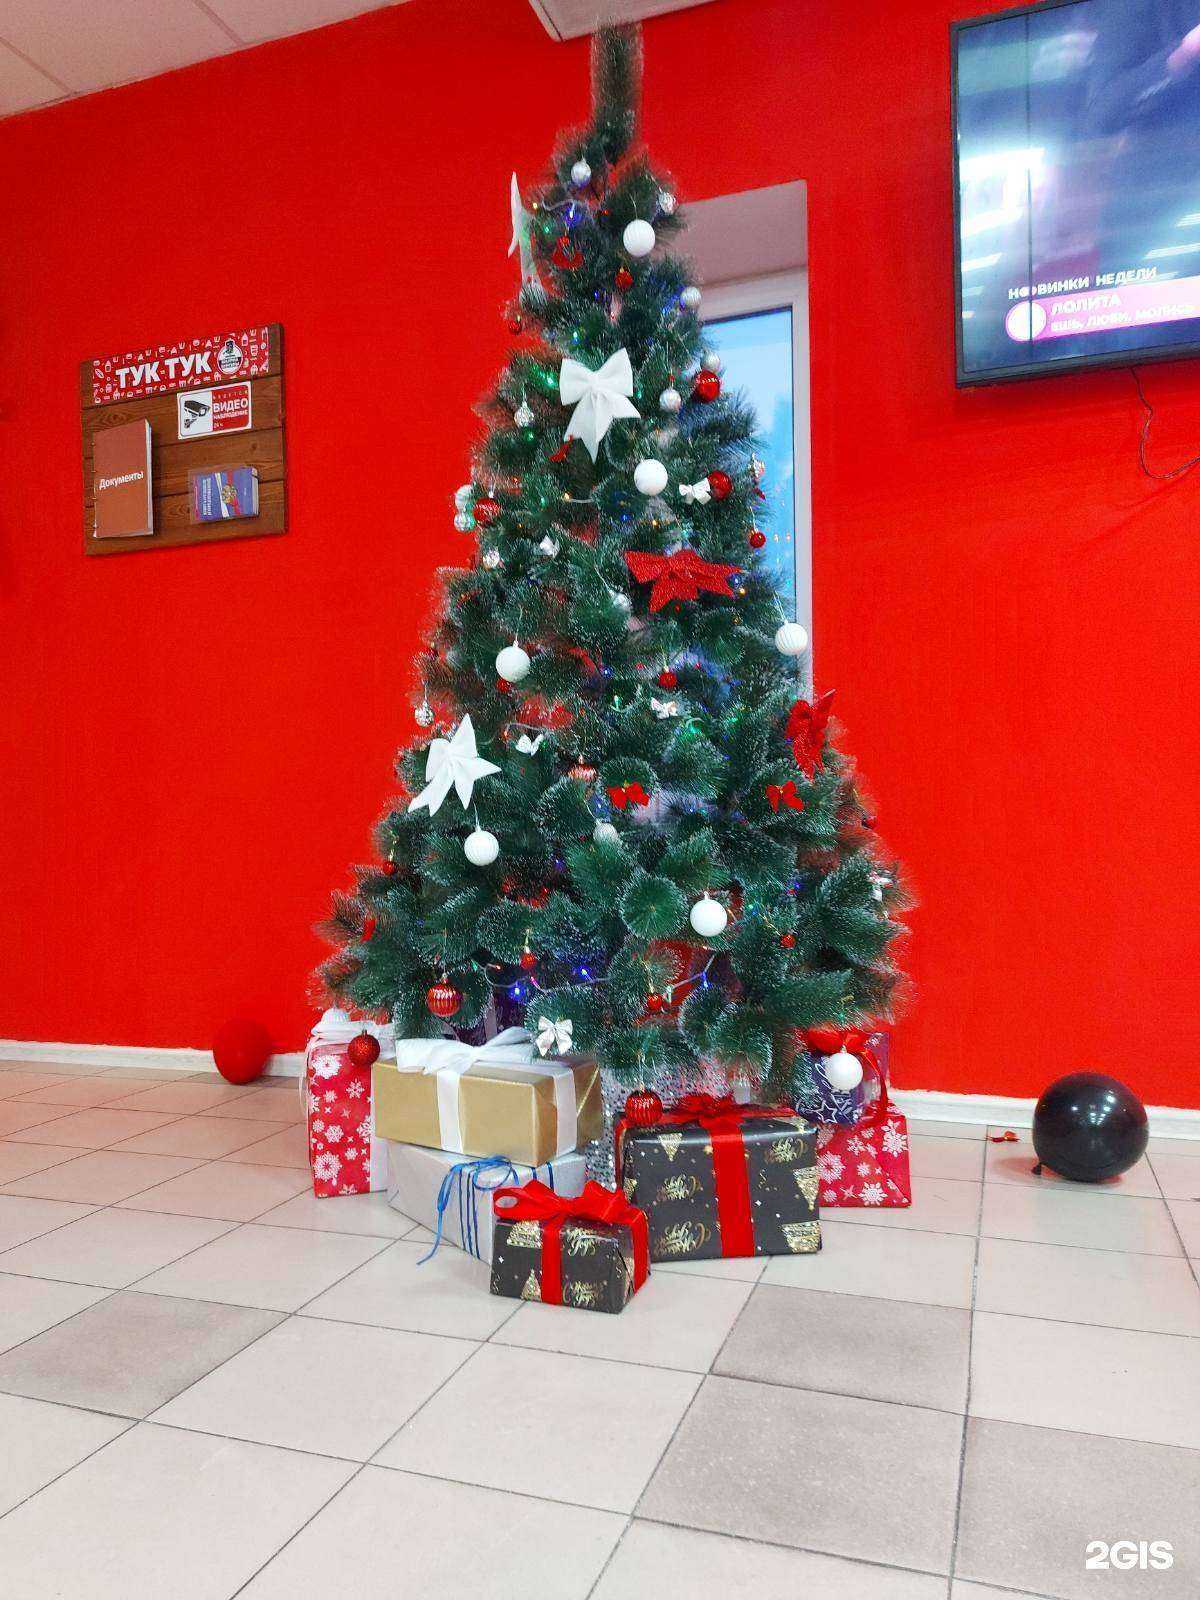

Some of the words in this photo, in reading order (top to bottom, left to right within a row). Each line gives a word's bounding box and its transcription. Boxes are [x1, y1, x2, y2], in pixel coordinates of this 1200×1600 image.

[1008, 276, 1089, 299] НОВИНКИ
[1095, 266, 1156, 286] НЕДЕЛИ
[1051, 294, 1121, 315] ЛОЛИТА
[115, 361, 160, 389] ТУК
[164, 351, 212, 379] ТУК
[213, 398, 248, 413] ВИДЕО
[99, 470, 144, 490] Документы
